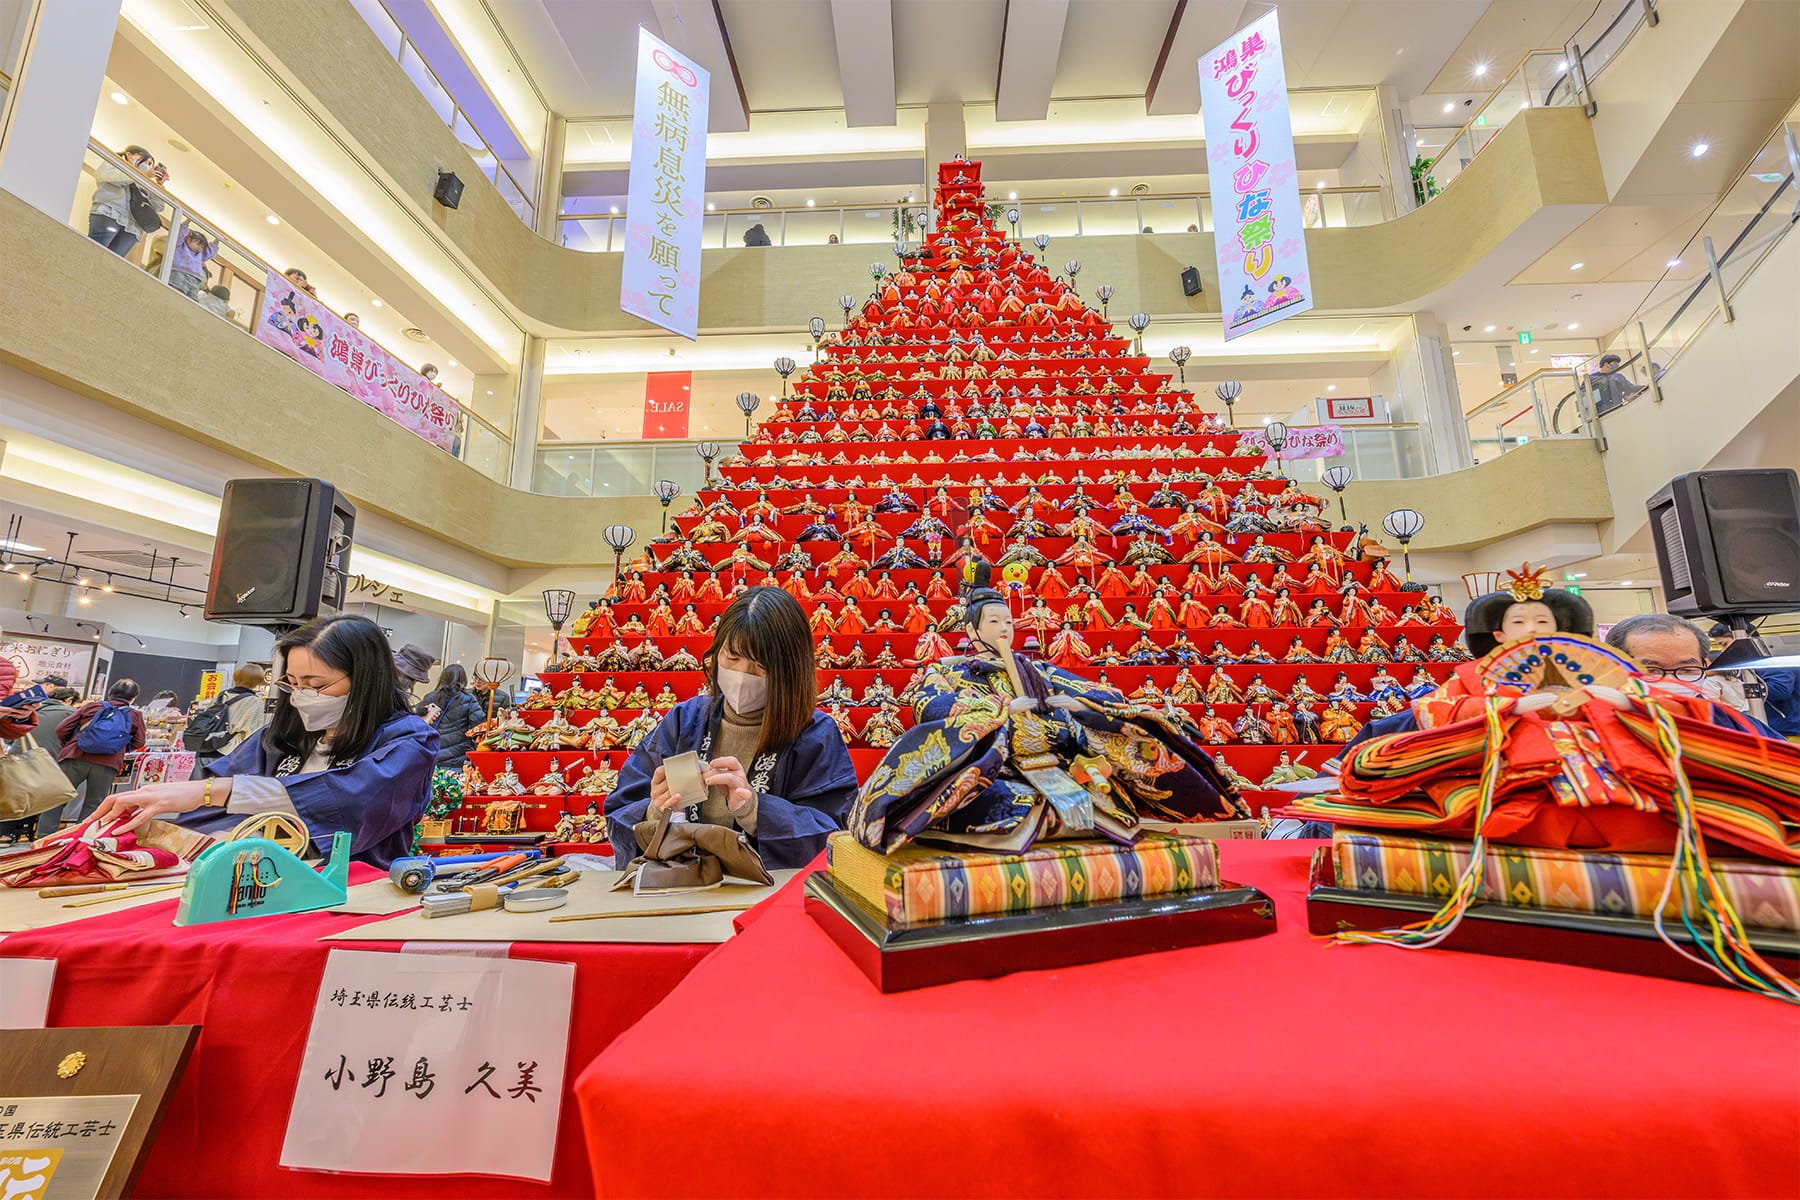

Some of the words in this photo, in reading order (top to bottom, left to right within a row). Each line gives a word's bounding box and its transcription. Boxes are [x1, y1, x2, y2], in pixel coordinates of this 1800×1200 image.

[1214, 32, 1265, 79] 鴻巣
[1225, 63, 1275, 280] びっくりひな祭り
[647, 80, 690, 317] 無病息災を願って
[330, 987, 473, 1012] 埼玉県伝統工芸士
[324, 1055, 436, 1100] 小野島
[464, 1060, 543, 1103] 久美
